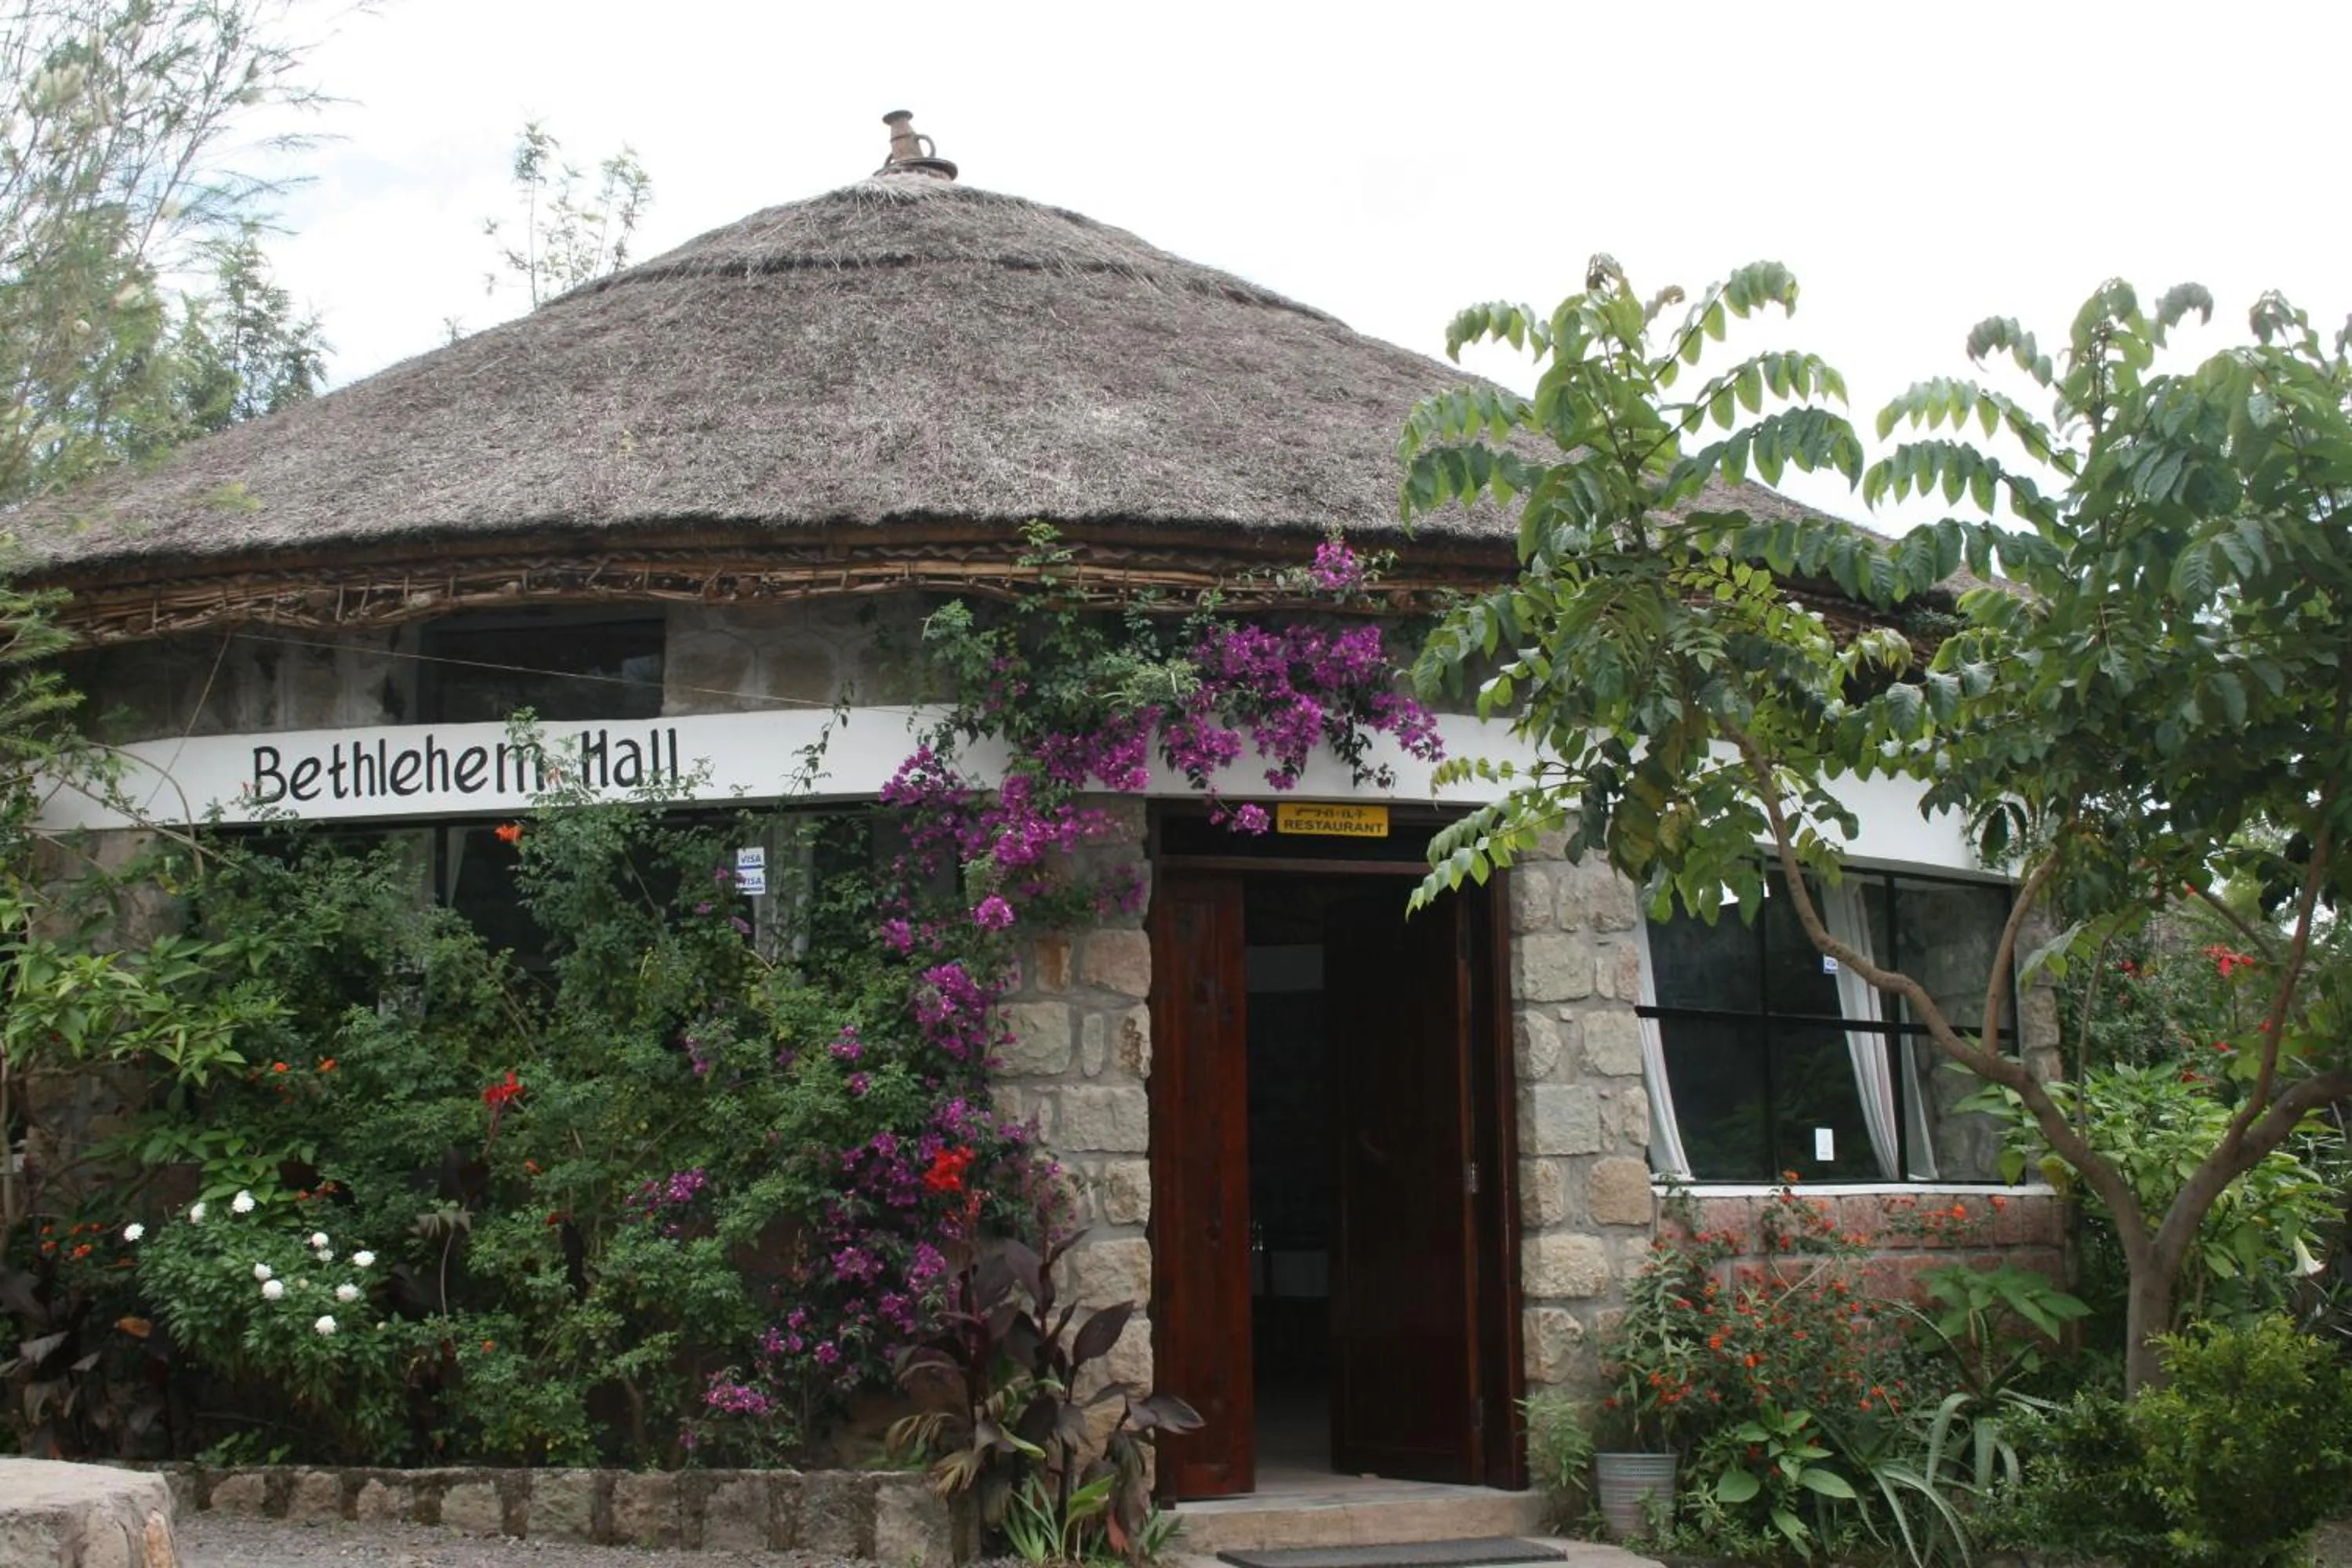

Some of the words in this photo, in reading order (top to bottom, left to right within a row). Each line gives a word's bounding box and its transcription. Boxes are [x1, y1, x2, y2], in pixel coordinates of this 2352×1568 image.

[253, 734, 546, 804] Bethlehem
[582, 728, 679, 788] Hall
[1283, 819, 1384, 833] RESTAURANT
[741, 854, 761, 864] VISA
